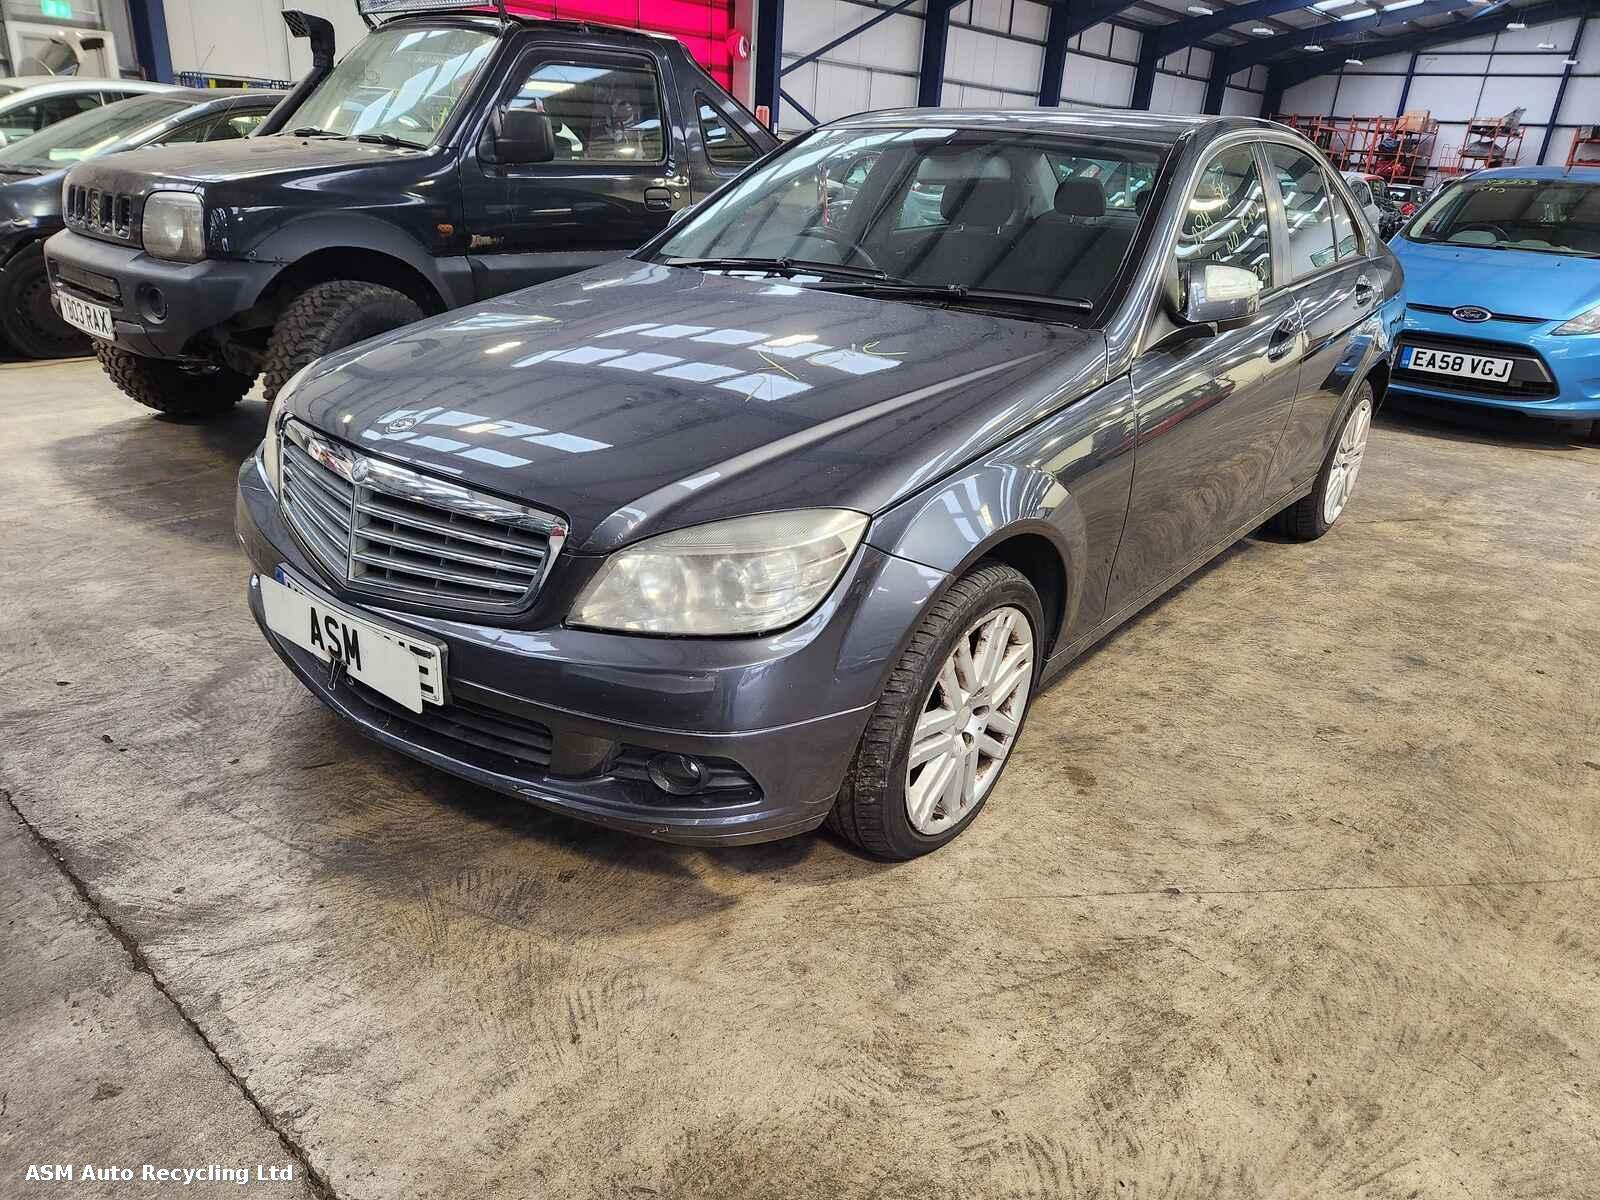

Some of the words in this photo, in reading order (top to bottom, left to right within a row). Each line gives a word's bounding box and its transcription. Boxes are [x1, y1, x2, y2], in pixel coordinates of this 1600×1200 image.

[85, 304, 109, 334] RAX
[1413, 350, 1465, 372] EA58
[1470, 358, 1509, 378] VGJ
[310, 606, 362, 672] ASM
